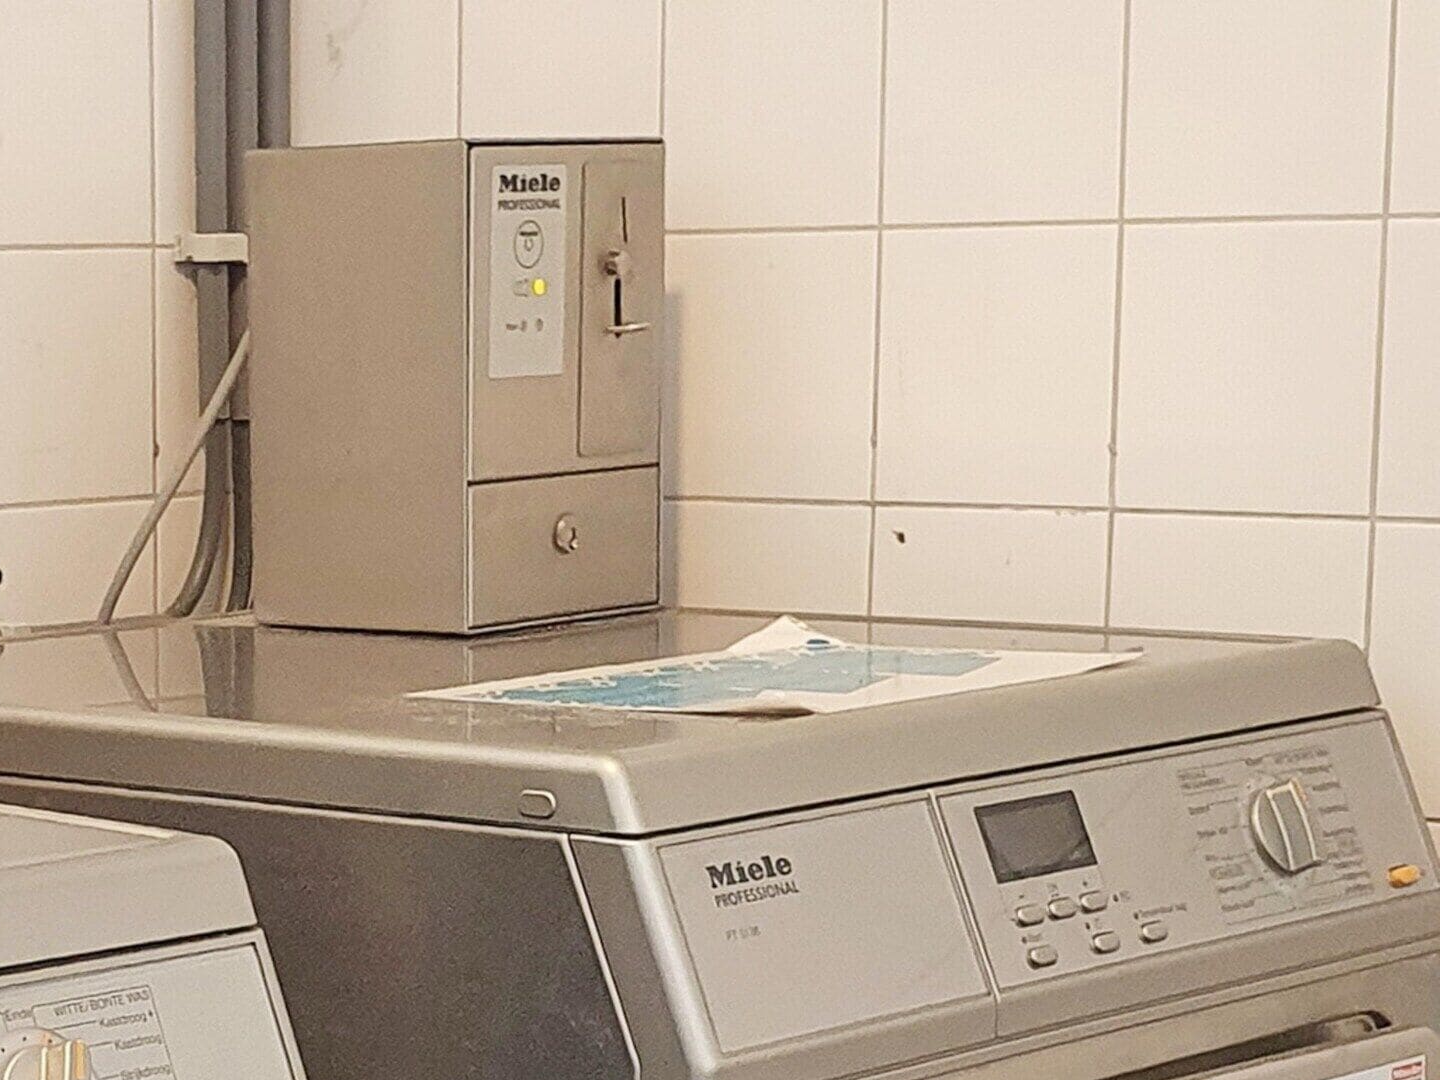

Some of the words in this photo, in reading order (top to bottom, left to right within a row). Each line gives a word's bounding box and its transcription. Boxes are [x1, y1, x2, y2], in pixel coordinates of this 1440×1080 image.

[498, 173, 560, 193] Miele
[498, 198, 560, 210] PROFESSIONAL
[706, 855, 793, 888] Miele
[715, 881, 800, 908] PROFESSIONAL
[114, 1035, 162, 1050] Kastdroog
